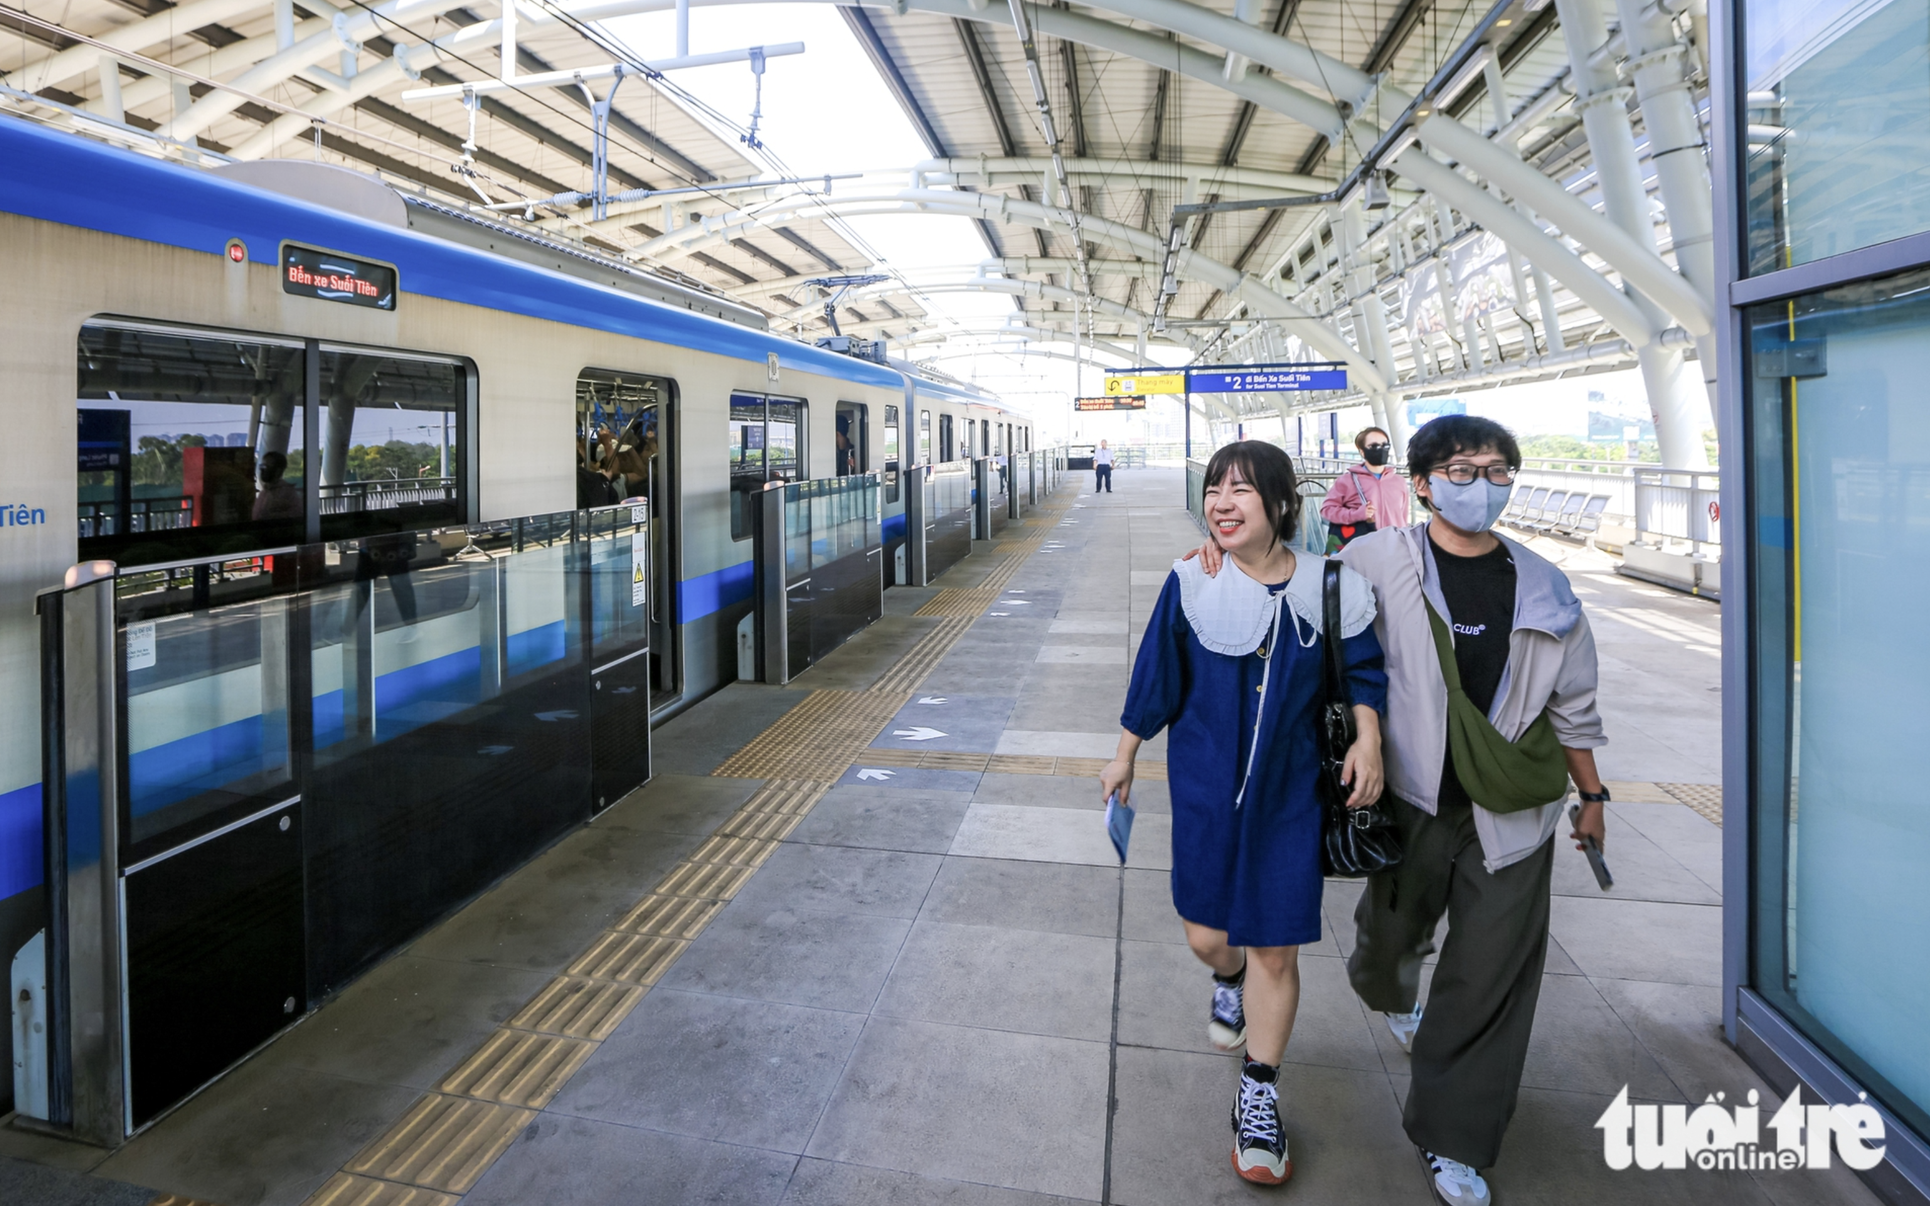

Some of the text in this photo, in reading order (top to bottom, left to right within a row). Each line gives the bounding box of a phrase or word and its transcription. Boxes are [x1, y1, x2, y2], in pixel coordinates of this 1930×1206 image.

[288, 265, 378, 297] Bến xe Suối Tiên
[1233, 376, 1242, 390] 2
[1268, 375, 1278, 383] Xe
[1075, 401, 1080, 409] 2
[0, 503, 46, 527] Tiên
